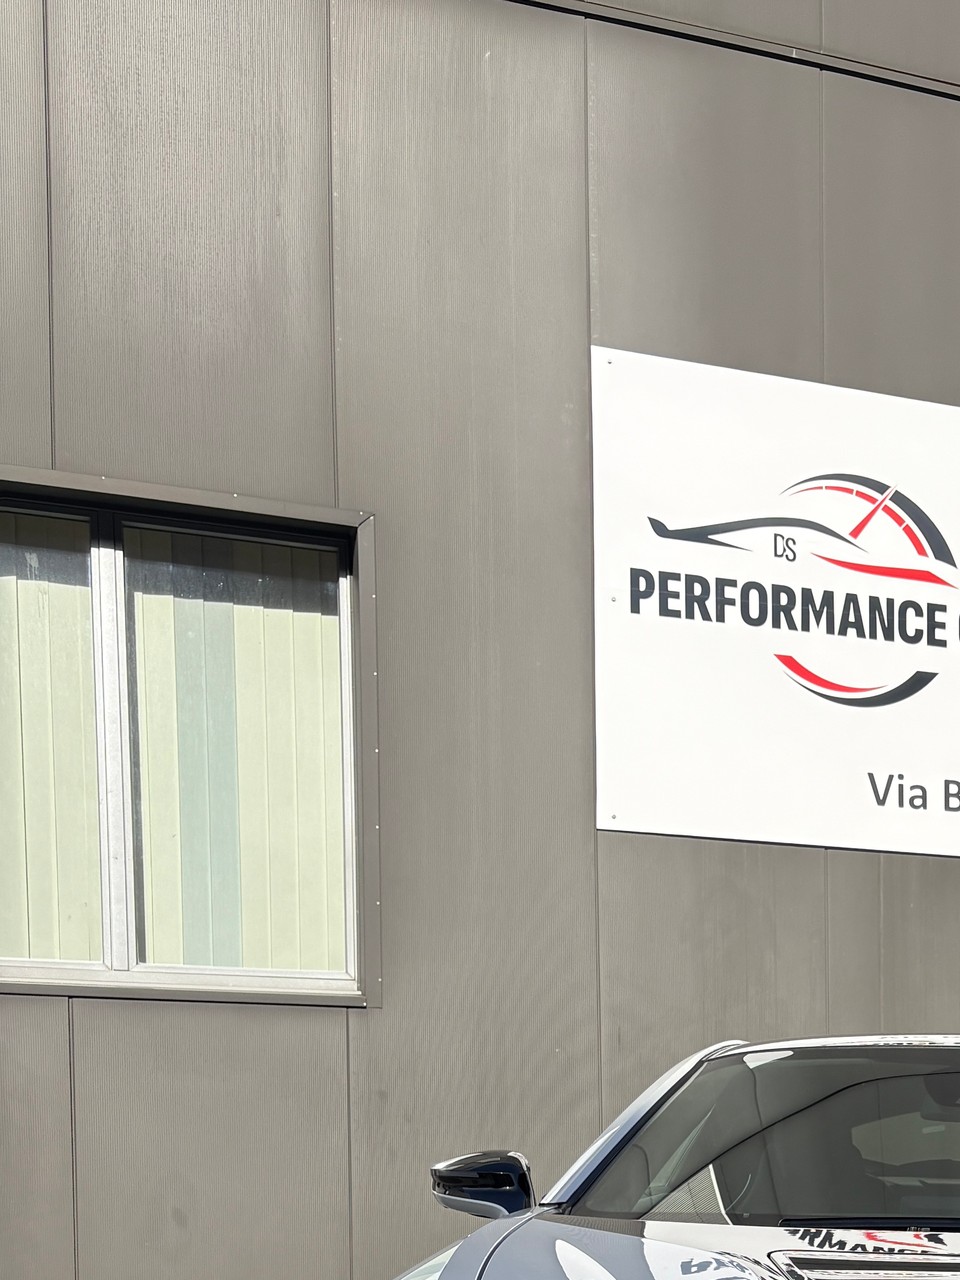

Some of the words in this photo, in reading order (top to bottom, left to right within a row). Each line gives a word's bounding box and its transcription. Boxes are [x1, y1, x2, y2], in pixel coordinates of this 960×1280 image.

[773, 532, 797, 563] DS
[629, 566, 947, 648] PERFORMANCE
[867, 772, 928, 810] Via
